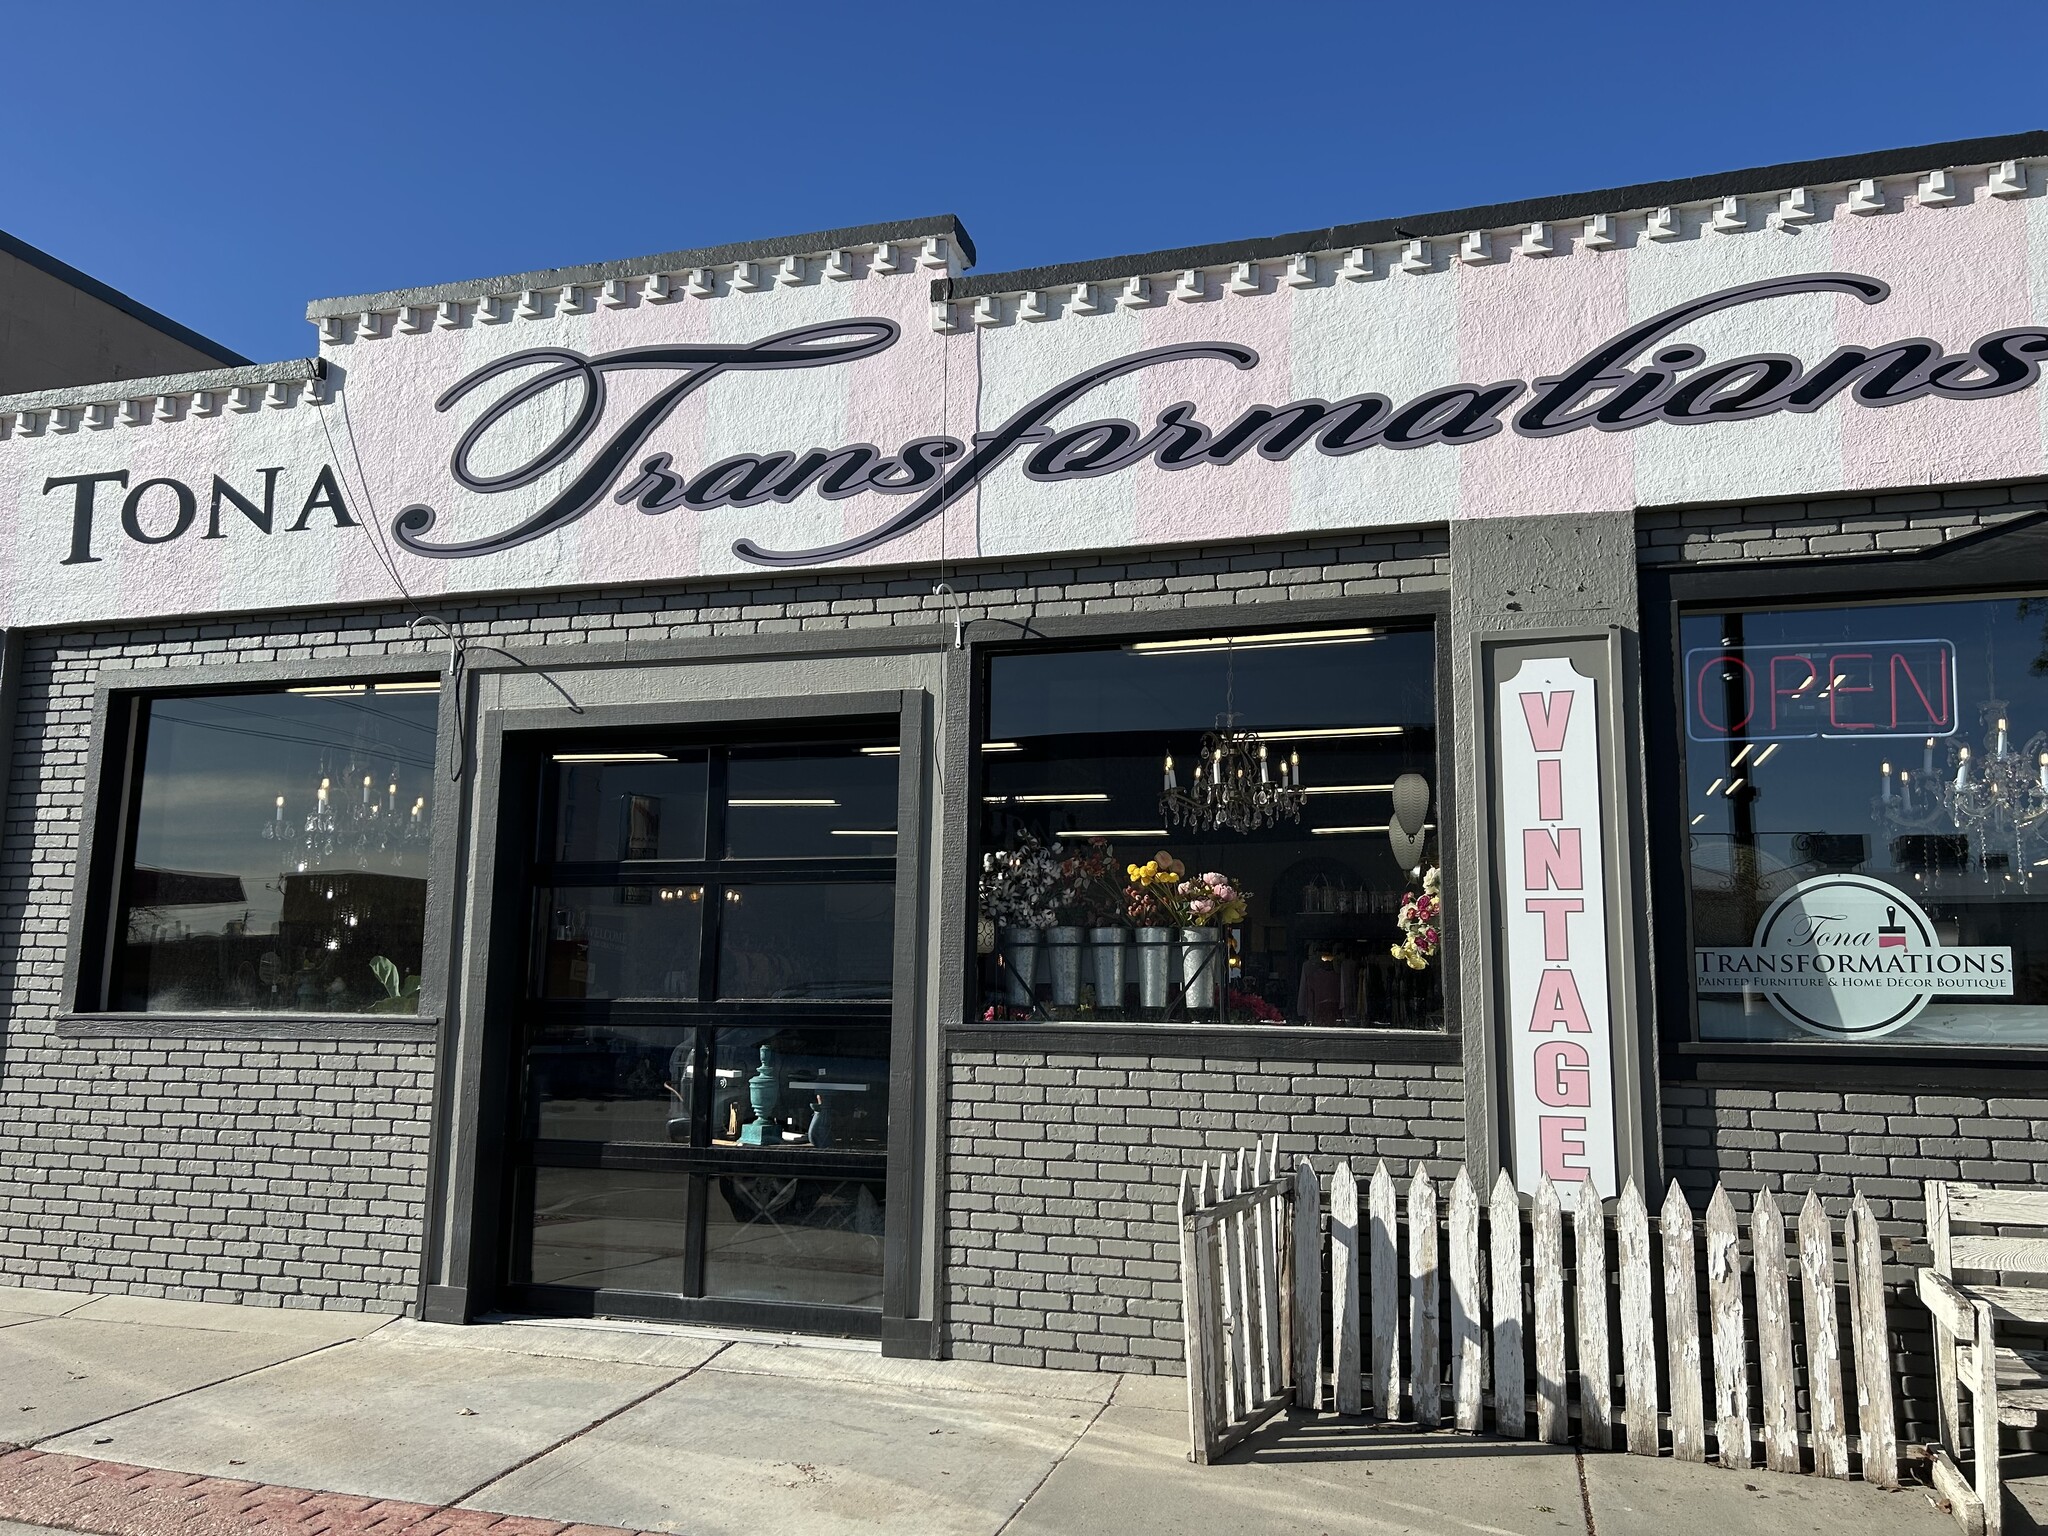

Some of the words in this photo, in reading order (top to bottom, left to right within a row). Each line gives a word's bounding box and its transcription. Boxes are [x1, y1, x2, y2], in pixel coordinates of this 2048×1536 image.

[43, 463, 361, 563] TONA
[397, 272, 2048, 566] Transformations
[1698, 649, 1949, 732] OPEN
[1518, 690, 1592, 1182] VINTAGE
[1787, 913, 1874, 949] Tona
[1696, 951, 2005, 973] TRANSFORMATIONS
[1698, 976, 1749, 987] PAINTED
[1753, 976, 1824, 987] FURNITURE
[1827, 977, 1837, 987] &
[1842, 977, 1882, 987] HOME
[1937, 977, 2007, 990] BOUTIQUE
